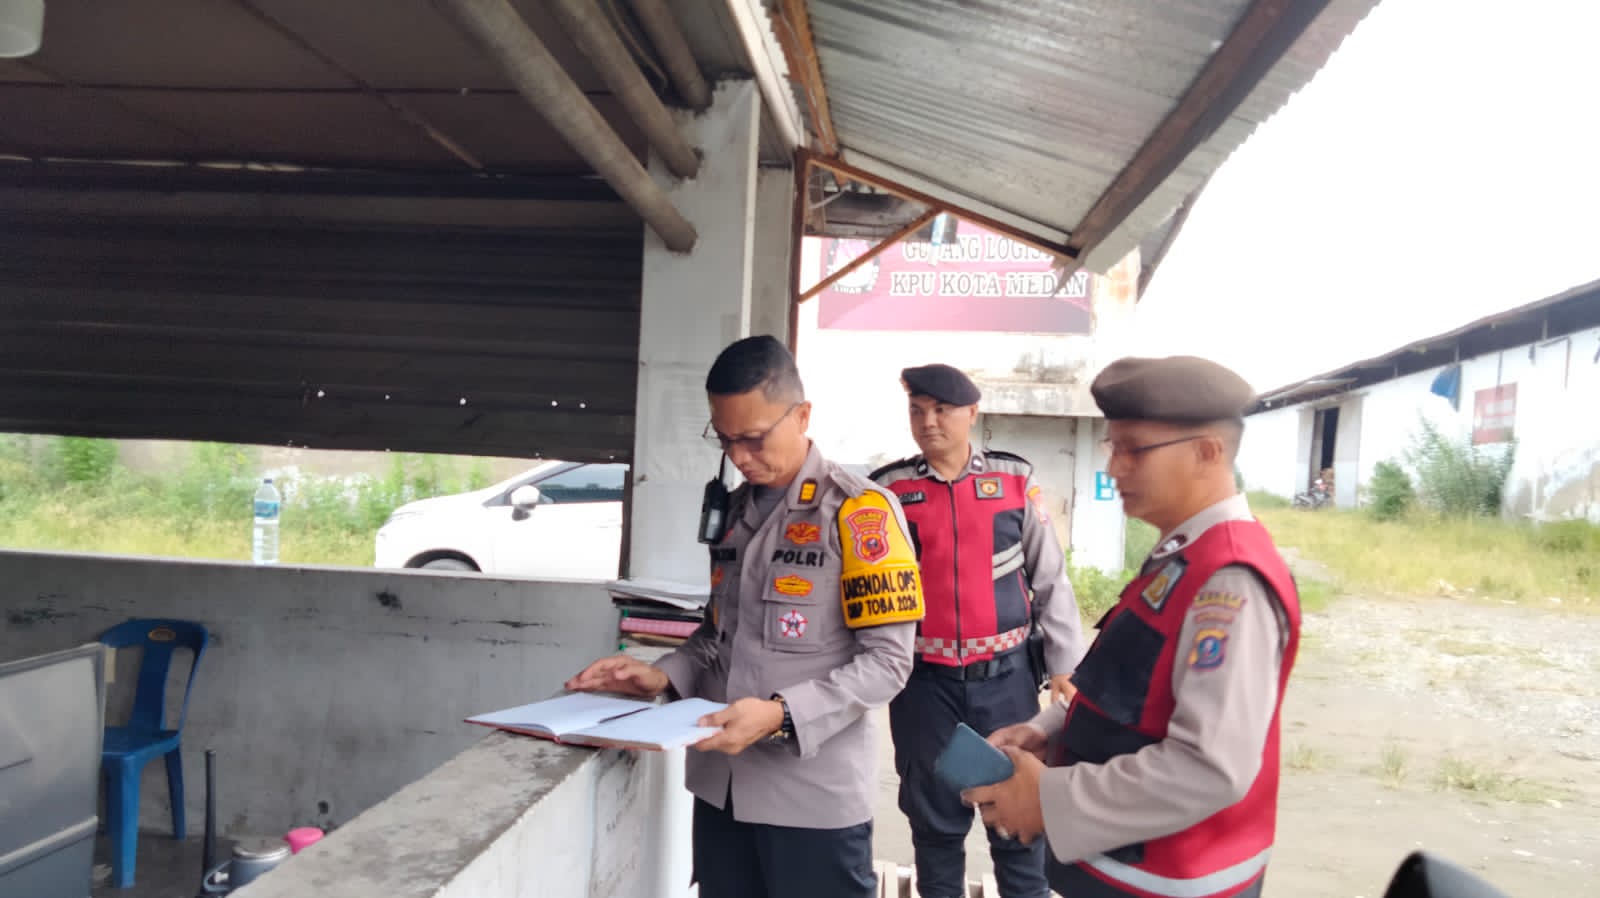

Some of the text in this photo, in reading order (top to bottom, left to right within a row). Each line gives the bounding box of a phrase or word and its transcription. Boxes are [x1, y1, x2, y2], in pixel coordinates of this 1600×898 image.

[904, 236, 980, 260] GUANG
[891, 272, 935, 295] KPU
[940, 273, 1001, 295] KOTA
[771, 549, 825, 569] POLRI
[896, 569, 917, 592] OPS
[864, 596, 896, 616] TOBA
[896, 594, 918, 612] 2024
